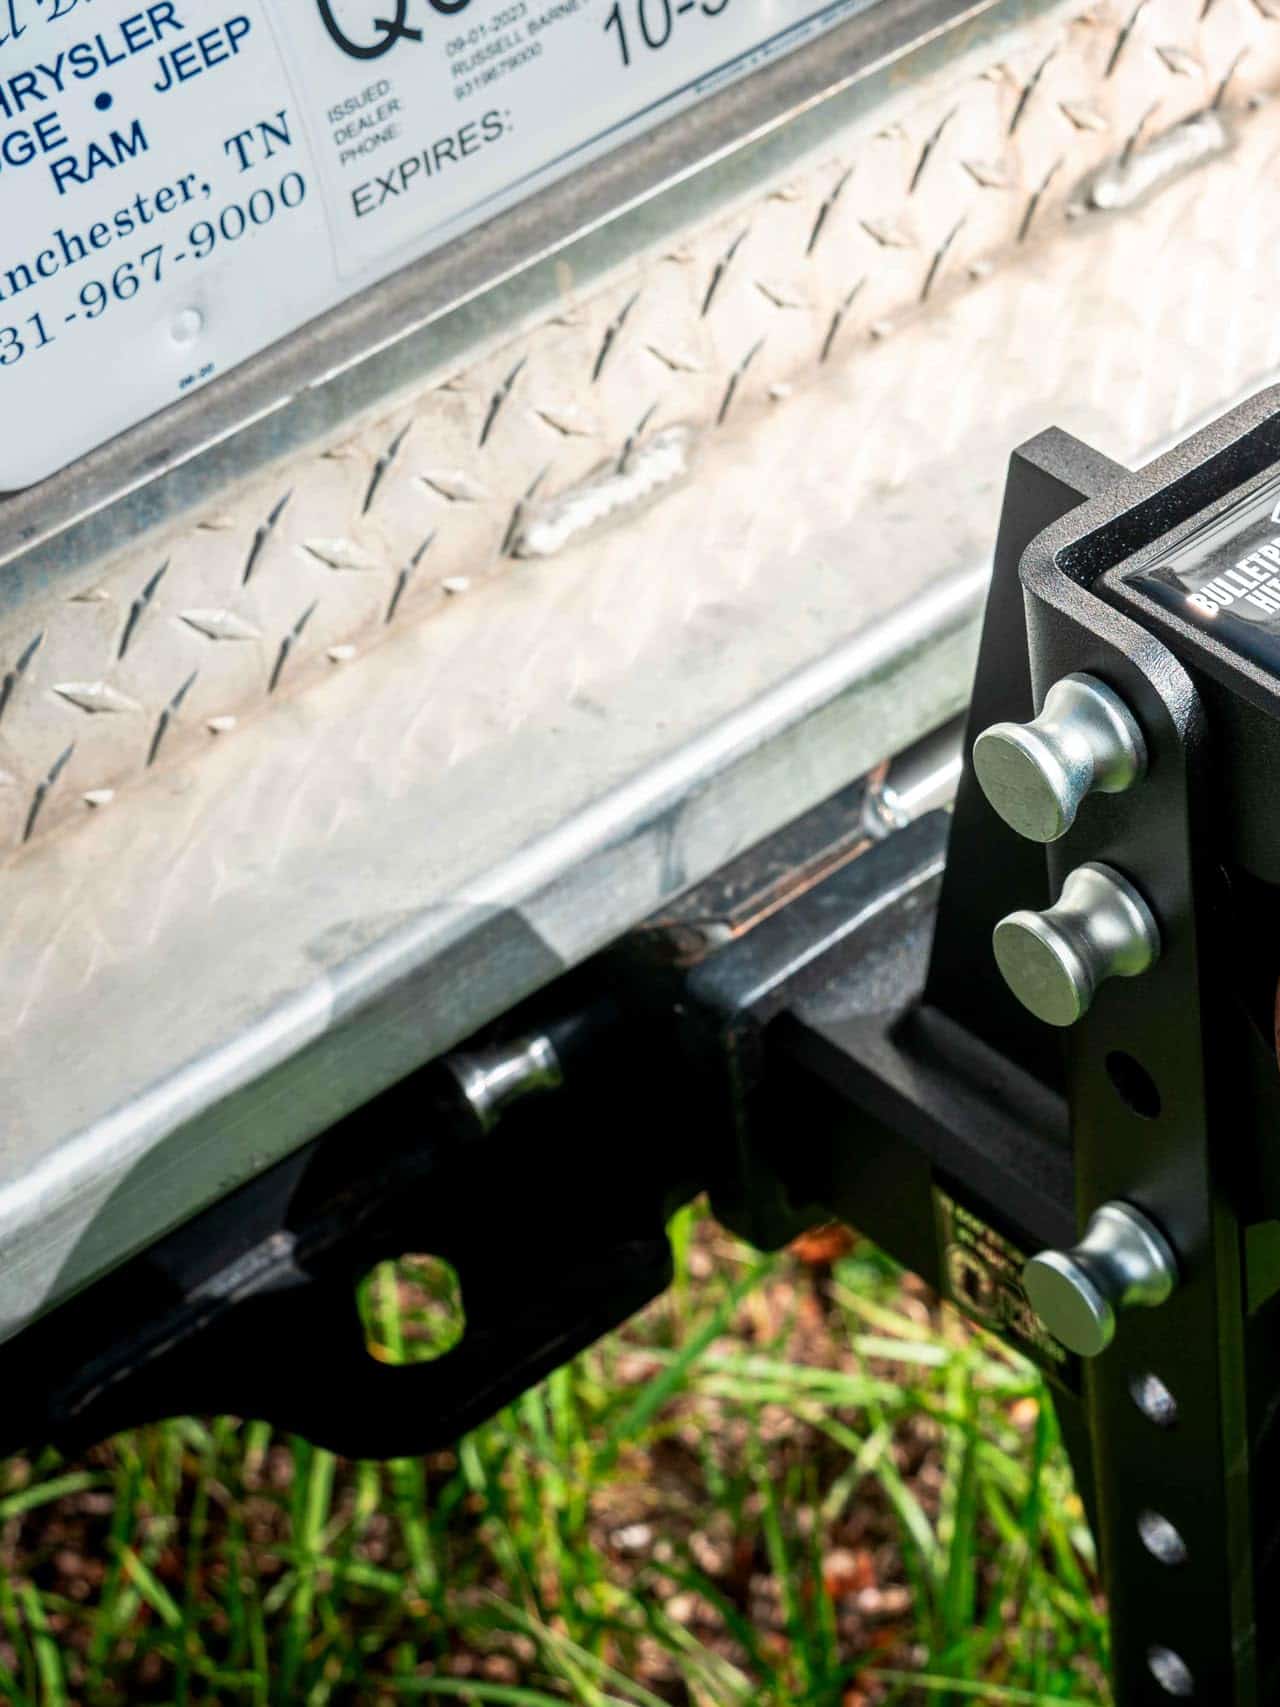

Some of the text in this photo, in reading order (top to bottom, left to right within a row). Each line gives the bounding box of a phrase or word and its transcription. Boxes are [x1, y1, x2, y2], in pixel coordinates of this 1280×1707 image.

[450, 0, 588, 77] RUSSELL BARNE
[603, 0, 728, 66] 10-
[0, 110, 68, 173] GE
[154, 15, 251, 93] JEEP
[327, 79, 391, 124] ISSUED
[333, 98, 401, 146] DEALER
[49, 119, 149, 195] RAM
[339, 127, 398, 166] PHONE
[351, 108, 514, 218] EXPIRES:
[0, 109, 293, 300] nchester, TN
